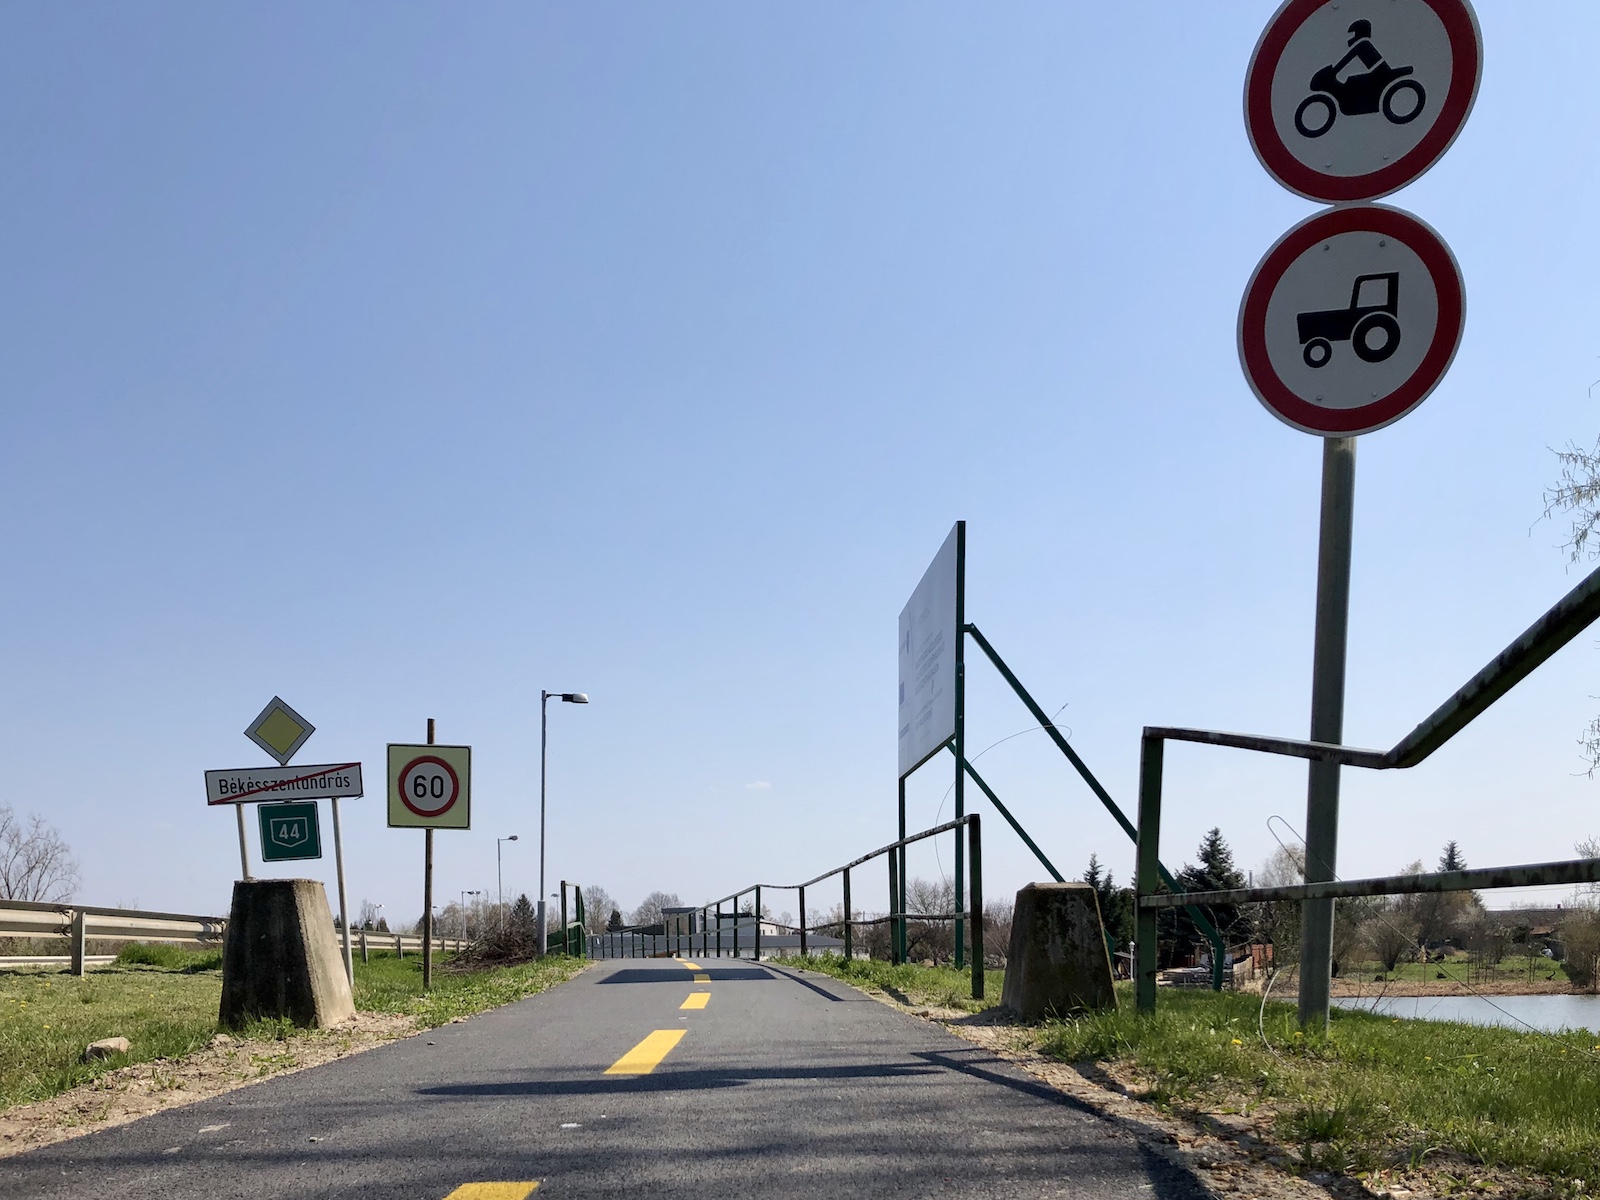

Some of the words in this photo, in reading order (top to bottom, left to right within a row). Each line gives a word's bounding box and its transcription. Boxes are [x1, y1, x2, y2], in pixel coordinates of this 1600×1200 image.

[218, 772, 351, 795] Békésszentandrás
[413, 774, 444, 798] 60
[278, 823, 300, 840] 44
